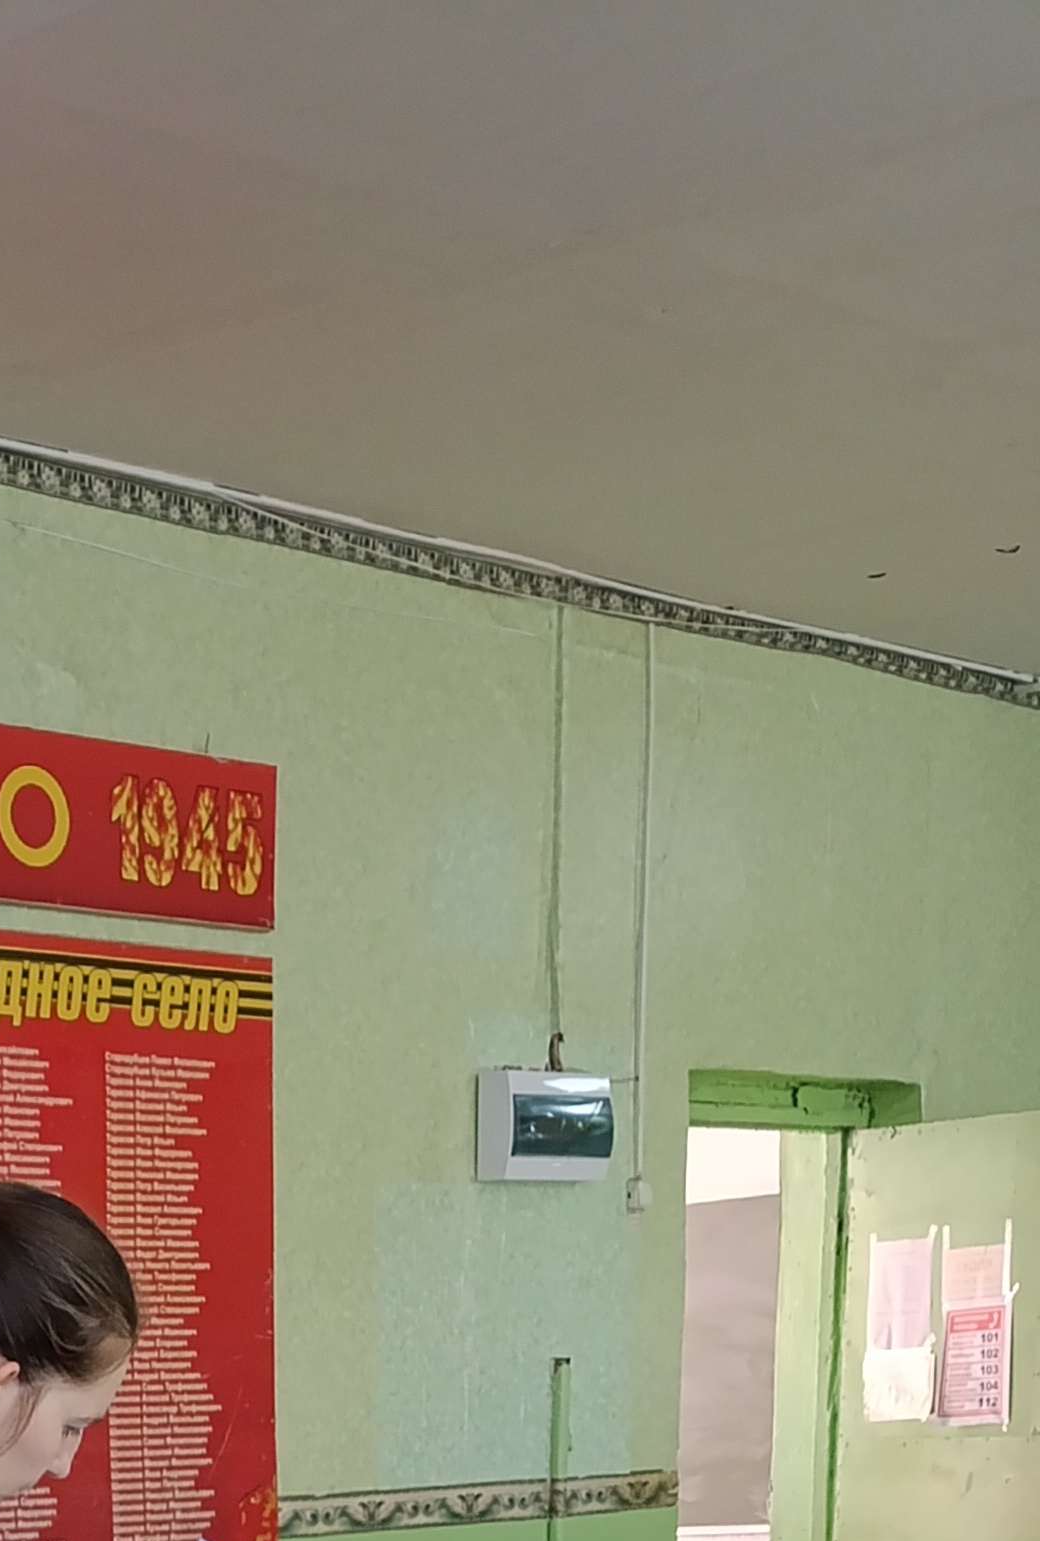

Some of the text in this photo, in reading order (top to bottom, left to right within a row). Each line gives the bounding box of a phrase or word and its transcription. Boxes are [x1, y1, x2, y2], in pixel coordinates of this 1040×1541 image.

[110, 774, 264, 896] 1945
[131, 970, 238, 1035] село
[980, 1332, 999, 1344] 101
[978, 1397, 999, 1408] 112
